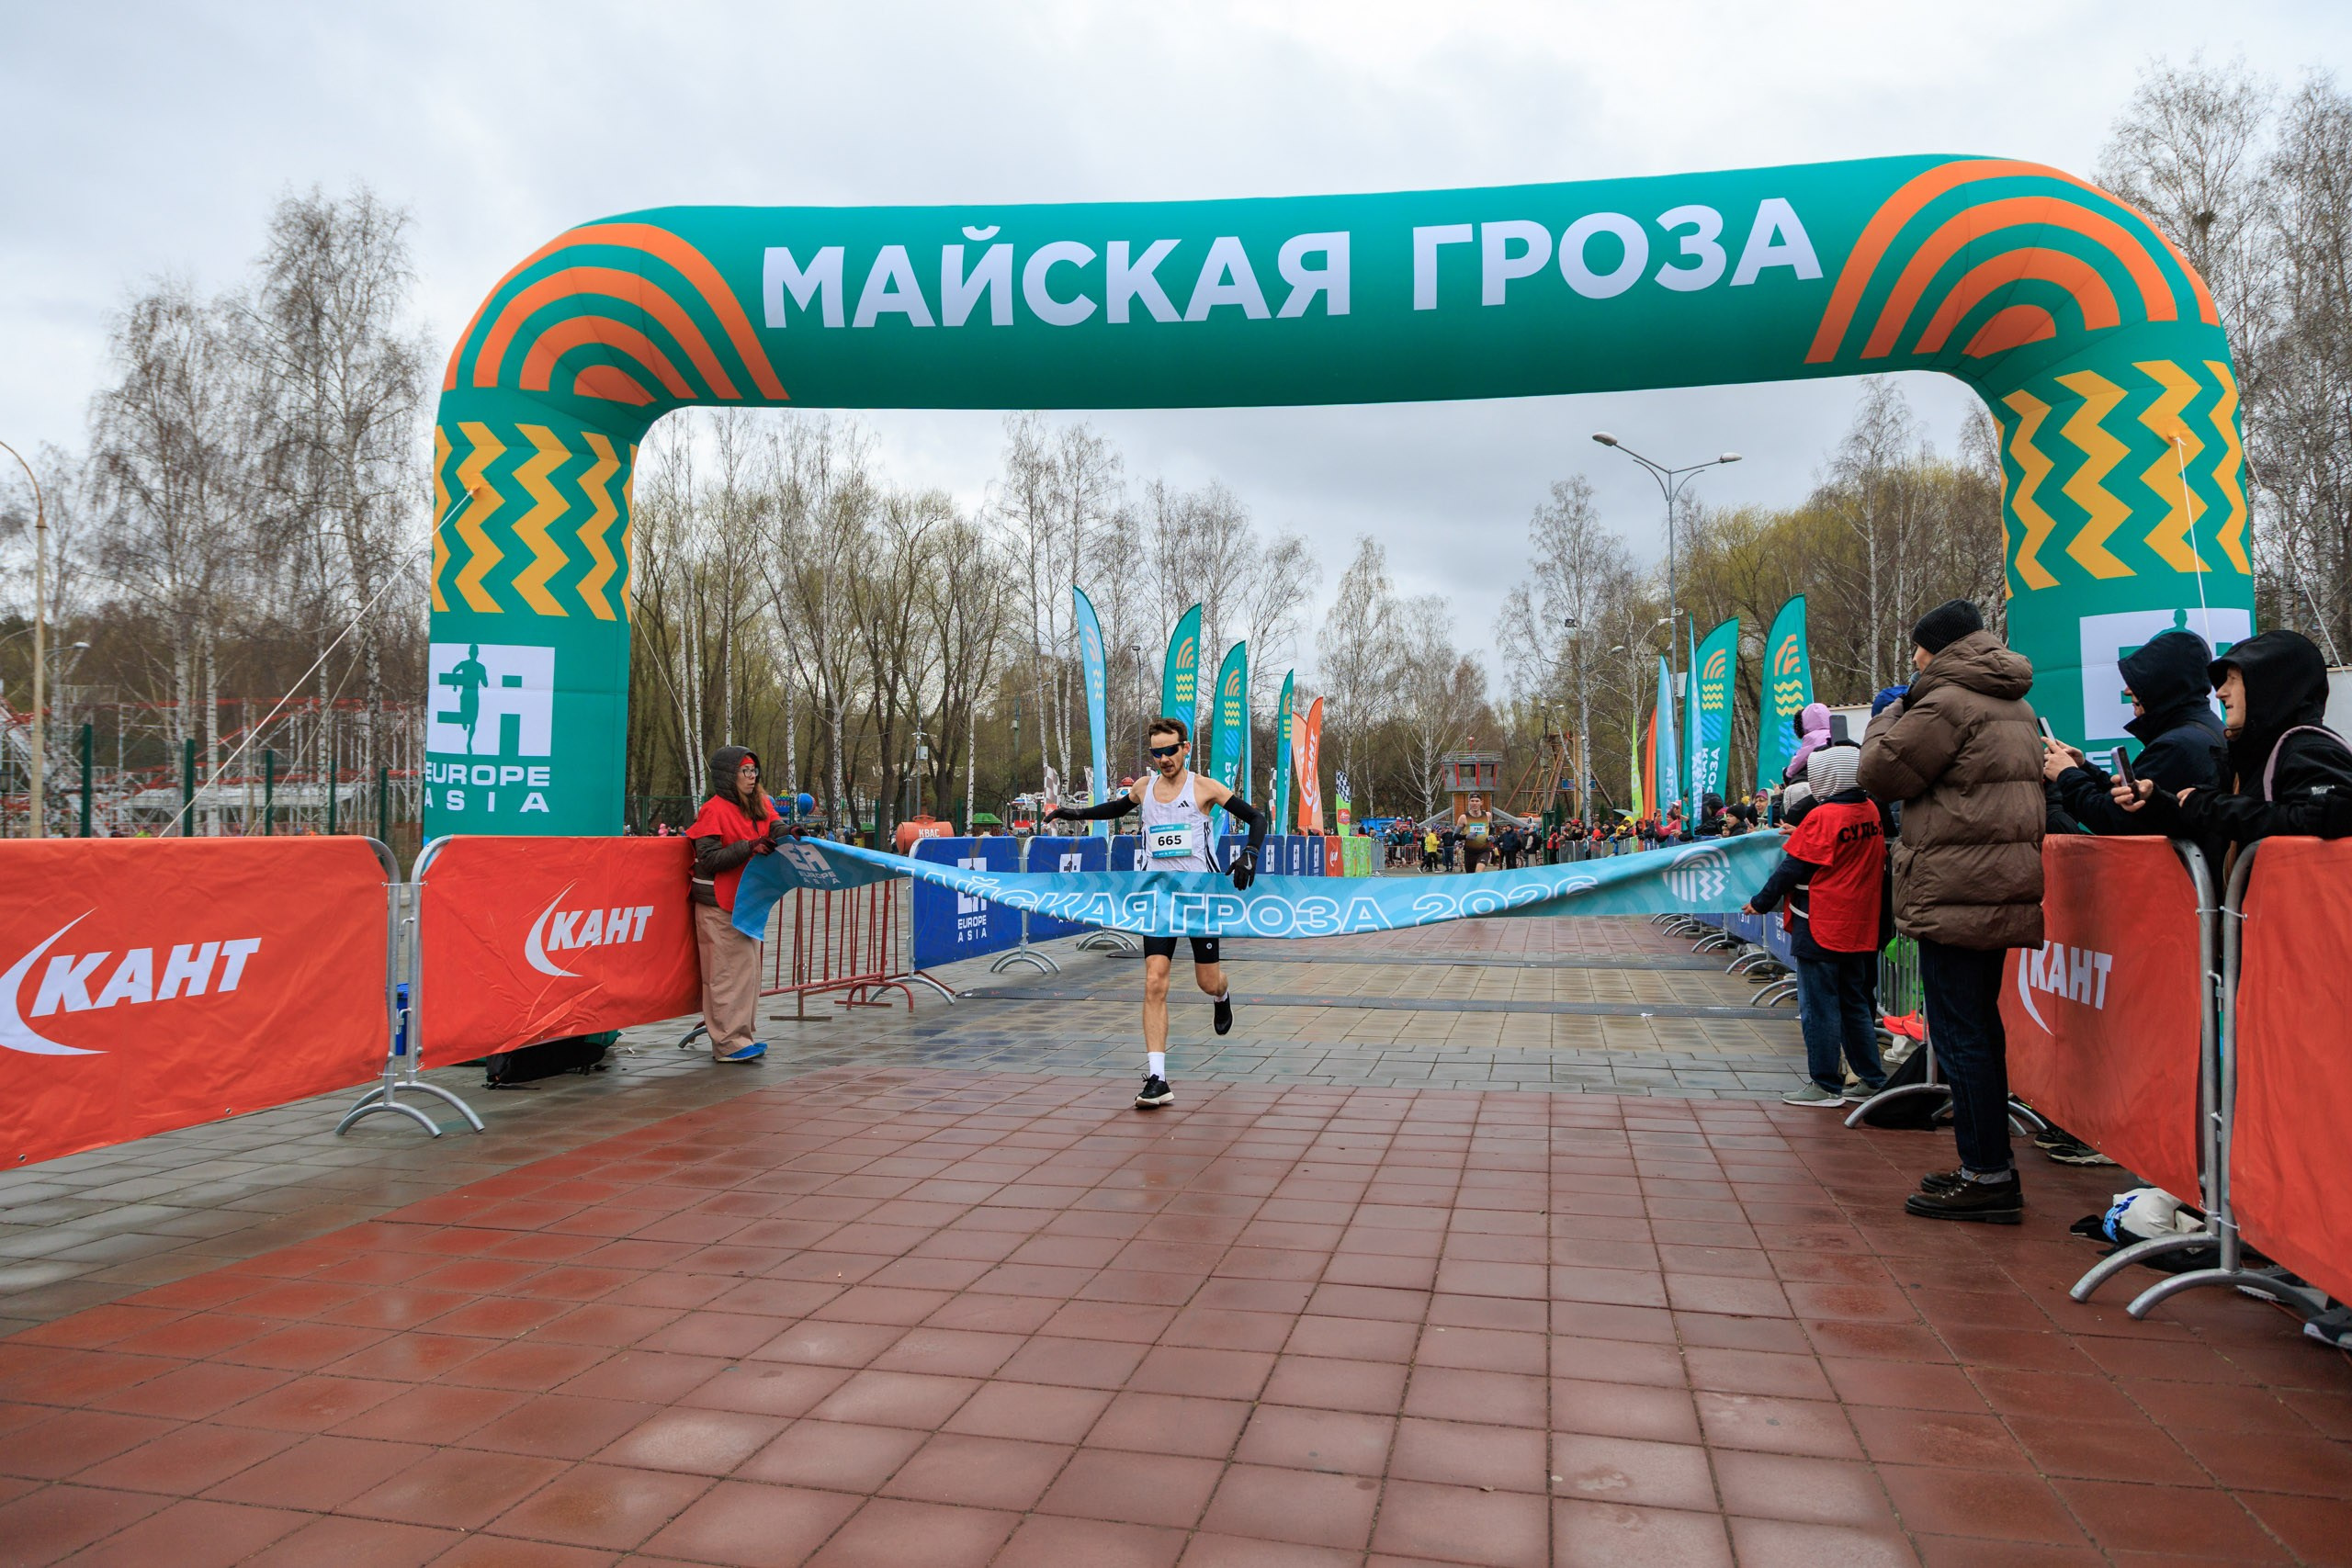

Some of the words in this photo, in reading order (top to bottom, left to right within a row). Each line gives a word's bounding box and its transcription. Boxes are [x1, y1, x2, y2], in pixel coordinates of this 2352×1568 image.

[763, 225, 1351, 329] МАЙСКАЯ
[1413, 197, 1824, 310] ГРОЗА
[425, 761, 551, 787] EUROPE
[1706, 747, 1721, 794] РОЗА
[424, 787, 550, 813] ASIA
[919, 829, 940, 838] КВАС
[1158, 835, 1182, 846] 665
[869, 862, 1158, 932] ЙСКАЯ
[1170, 891, 1394, 939] ГРОЗА
[546, 906, 653, 953] КАНТ
[957, 915, 987, 930] EUROPE
[957, 928, 988, 943] ASIA
[30, 938, 262, 1018] КАНТ
[2030, 940, 2112, 1010] КАНТ
